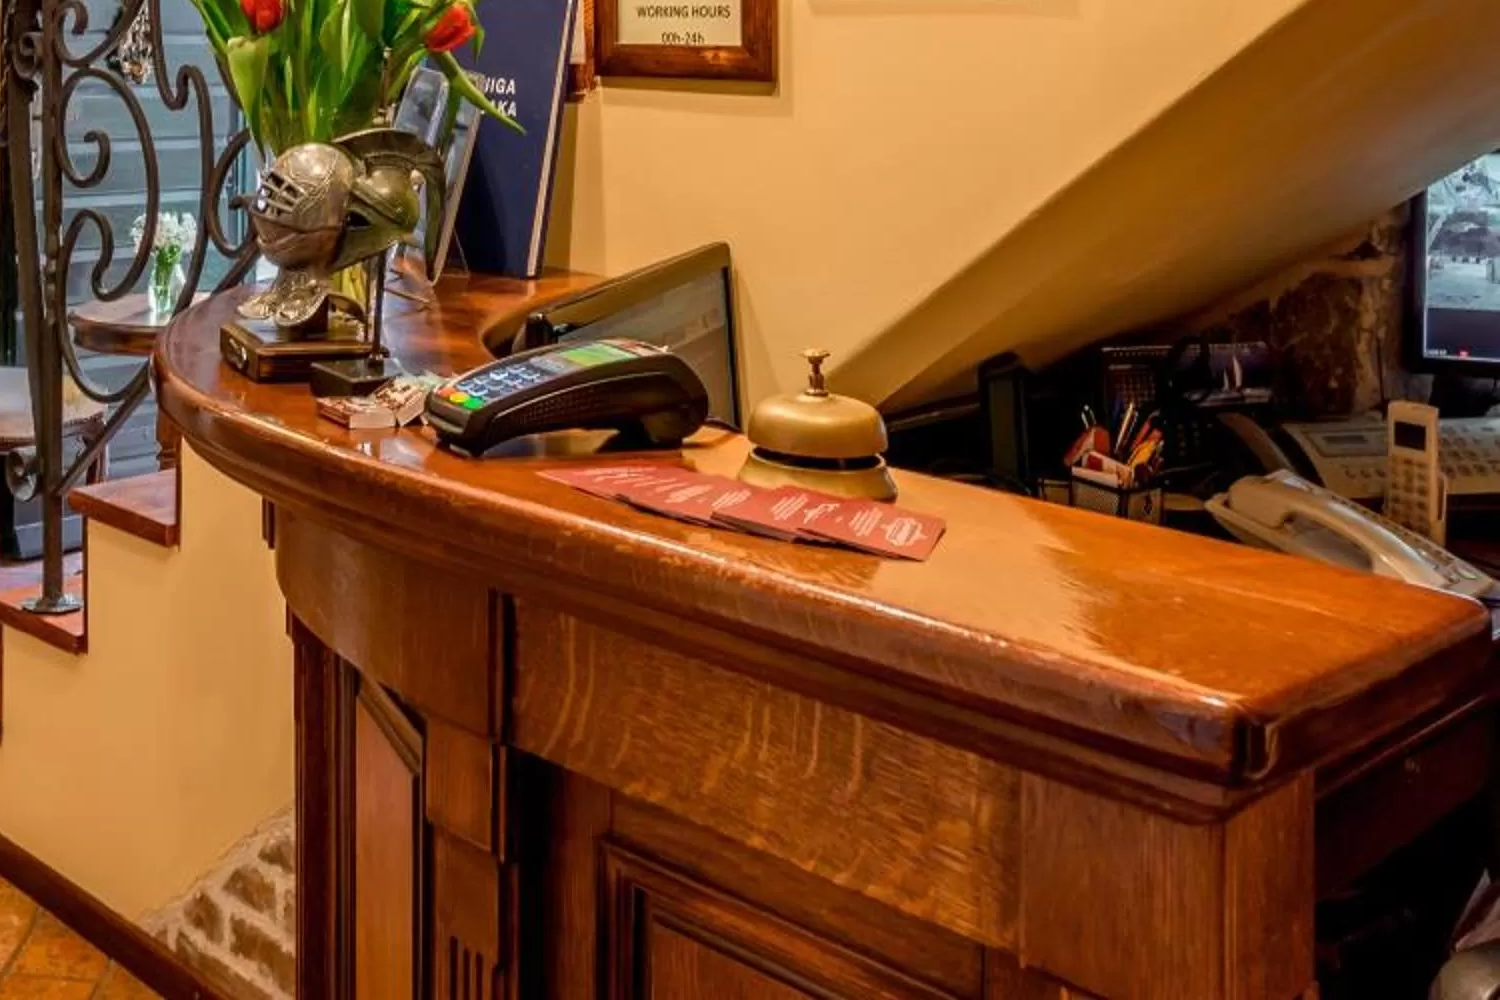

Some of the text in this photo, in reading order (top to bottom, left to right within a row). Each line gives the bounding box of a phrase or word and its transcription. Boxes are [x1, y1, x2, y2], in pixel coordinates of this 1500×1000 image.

[636, 4, 731, 19] WORKING HOURS
[661, 31, 705, 45] 00h-24h
